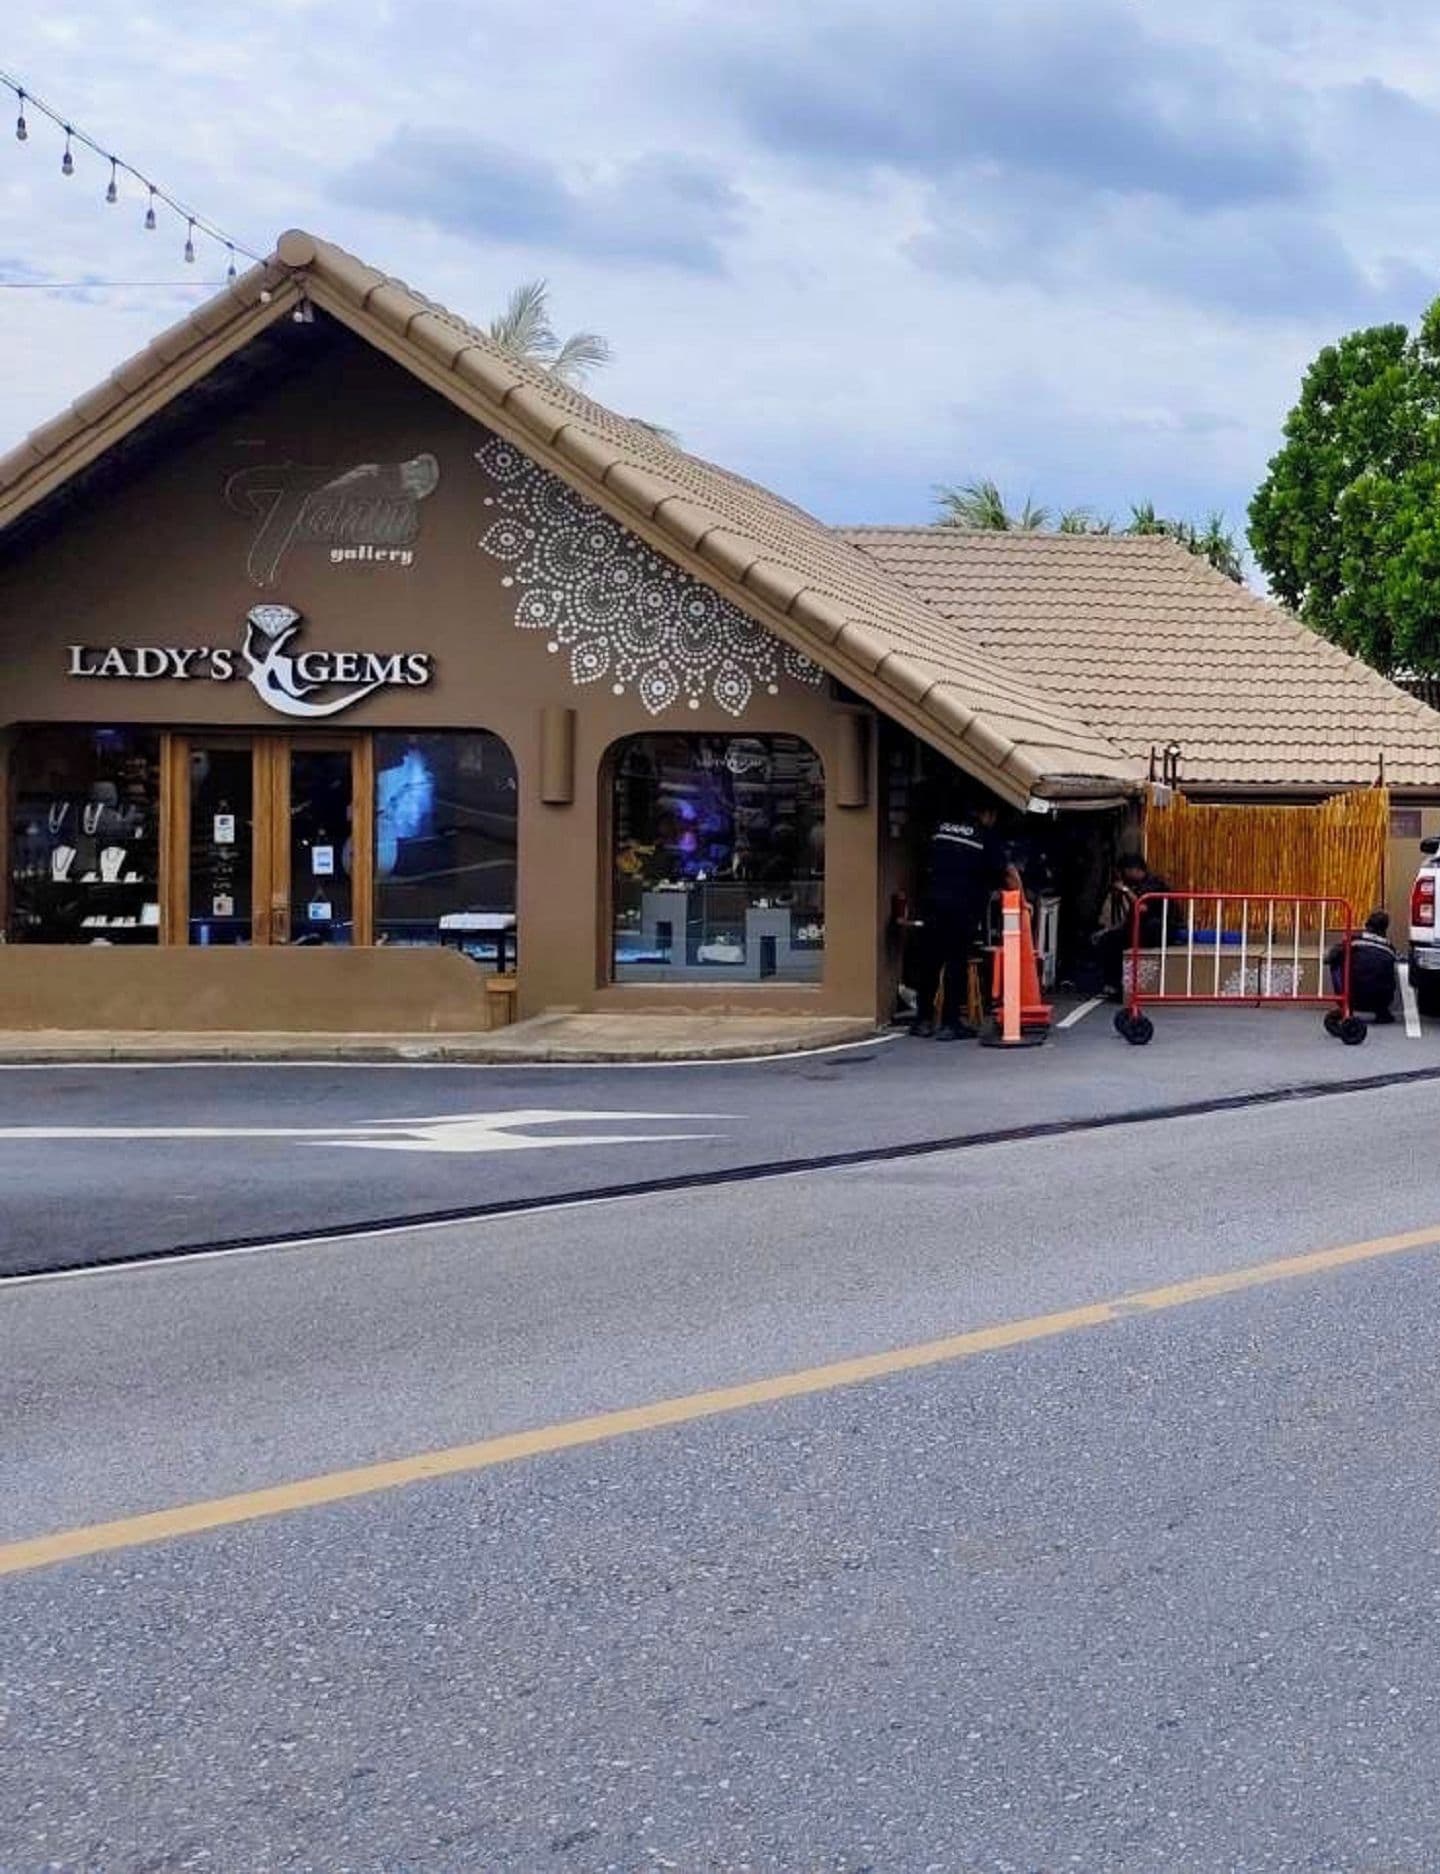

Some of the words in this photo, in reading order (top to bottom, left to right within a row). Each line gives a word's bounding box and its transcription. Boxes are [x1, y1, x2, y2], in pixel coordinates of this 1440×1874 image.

[330, 545, 413, 565] gallery
[69, 646, 233, 681] LADY'S
[299, 651, 430, 685] GEMS
